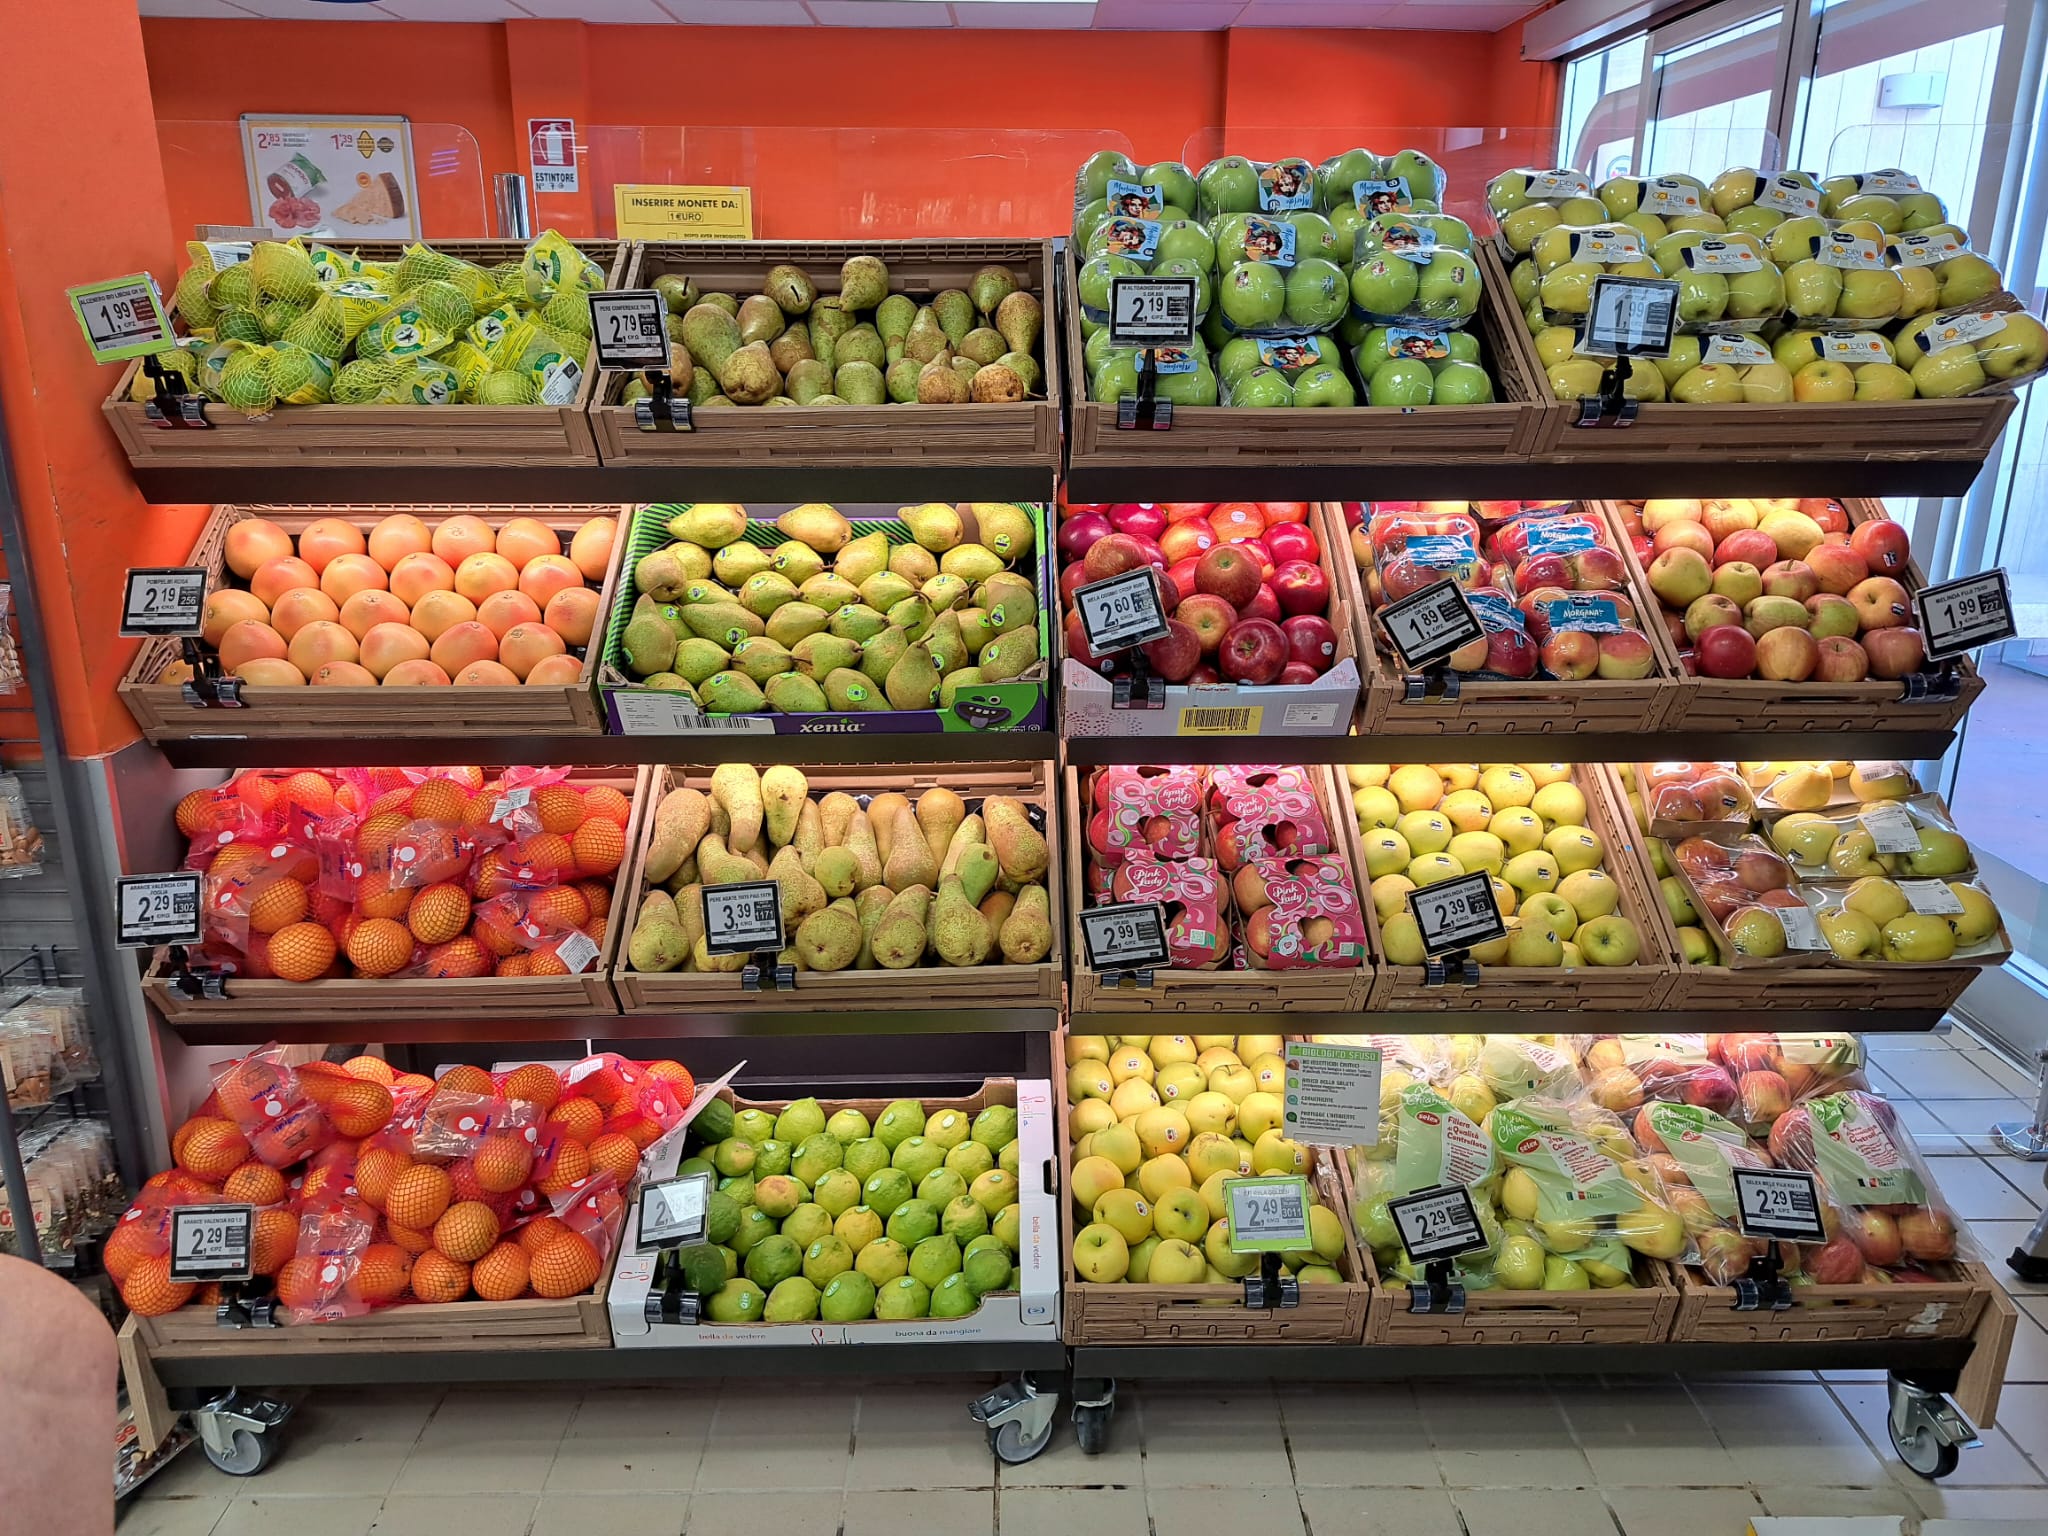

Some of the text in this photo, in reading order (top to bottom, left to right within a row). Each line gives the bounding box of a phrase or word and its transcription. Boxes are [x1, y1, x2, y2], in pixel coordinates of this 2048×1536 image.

[535, 172, 575, 183] ESTINTORE
[631, 197, 739, 209] INSERIRE MONETE DA:
[1131, 296, 1164, 323] 2,19
[101, 302, 131, 334] 1,99
[609, 314, 637, 344] 2,79
[642, 324, 657, 335] 579
[143, 586, 176, 613] 2,19
[180, 596, 197, 605] 256
[1983, 600, 2000, 612] 227
[1100, 596, 1130, 627] 2,60
[1563, 608, 1600, 618] MORGANA
[1943, 598, 1976, 629] 1,99
[1409, 609, 1439, 641] 1,89
[799, 722, 862, 733] xenia
[1162, 788, 1187, 799] Lady
[1164, 794, 1191, 806] Pink
[1234, 797, 1258, 811] Pink
[1242, 803, 1264, 816] Lady
[1132, 868, 1161, 883] Pink
[1140, 874, 1166, 890] Lady
[1272, 883, 1299, 898] Pink
[1280, 891, 1304, 905] Lady
[137, 895, 170, 922] 2,29
[174, 902, 195, 913] 1302
[1434, 898, 1466, 930] 2,39
[1474, 902, 1486, 912] 23
[722, 903, 751, 930] 3,39
[1103, 924, 1134, 950] 2,99
[1302, 1047, 1377, 1061] BIOLOGICO SFUSO
[1417, 1113, 1439, 1123] selex
[1447, 1115, 1471, 1129] Filiera
[1453, 1126, 1479, 1141] Qualità
[1447, 1132, 1488, 1150] Controllata
[1518, 1140, 1539, 1152] selex
[1424, 1201, 1444, 1209] GOLDEN
[1756, 1188, 1788, 1214] 2,29
[1247, 1198, 1278, 1227] 2,49
[1282, 1206, 1302, 1218] 3011
[1415, 1209, 1447, 1239] 2,29
[191, 1227, 222, 1255] 2,29
[1032, 1216, 1042, 1271] bella da vedere
[895, 1327, 982, 1338] buona da mangiare
